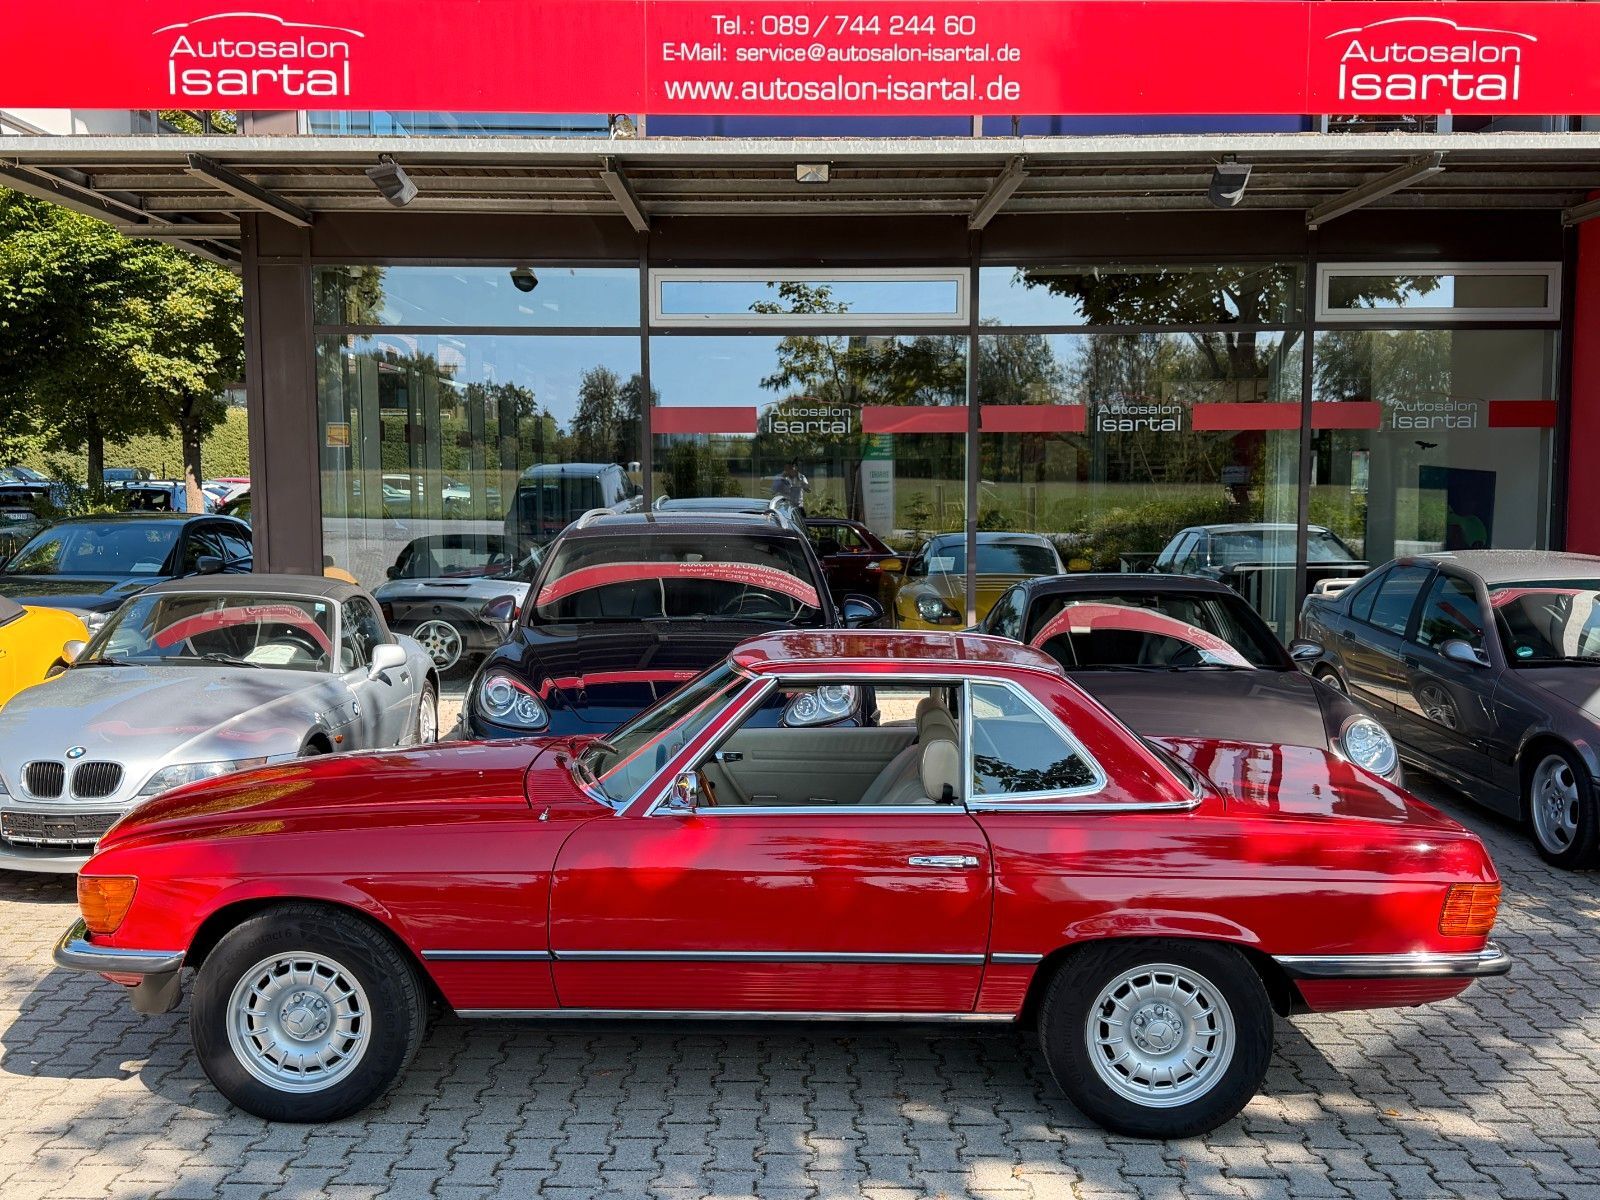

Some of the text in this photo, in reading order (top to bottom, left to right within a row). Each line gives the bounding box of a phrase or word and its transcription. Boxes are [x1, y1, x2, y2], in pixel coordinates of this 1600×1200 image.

[712, 15, 975, 37] Tel.: 089 / 744 244 60
[170, 36, 349, 58] Autosalon
[663, 43, 1020, 62] E-Mail: service@autosalon-isartal.de
[1341, 40, 1520, 62] Autosalon
[169, 60, 349, 95] Isartal
[1339, 64, 1519, 100] Isartal
[665, 75, 1020, 100] www.autosalon-isartal.de
[769, 406, 851, 416] Autosalon
[1098, 404, 1181, 415] Autosalon
[1394, 401, 1478, 412] Autosalon
[768, 417, 851, 434] Isartal
[1097, 415, 1181, 432] Isartal
[1392, 412, 1477, 429] Isartal
